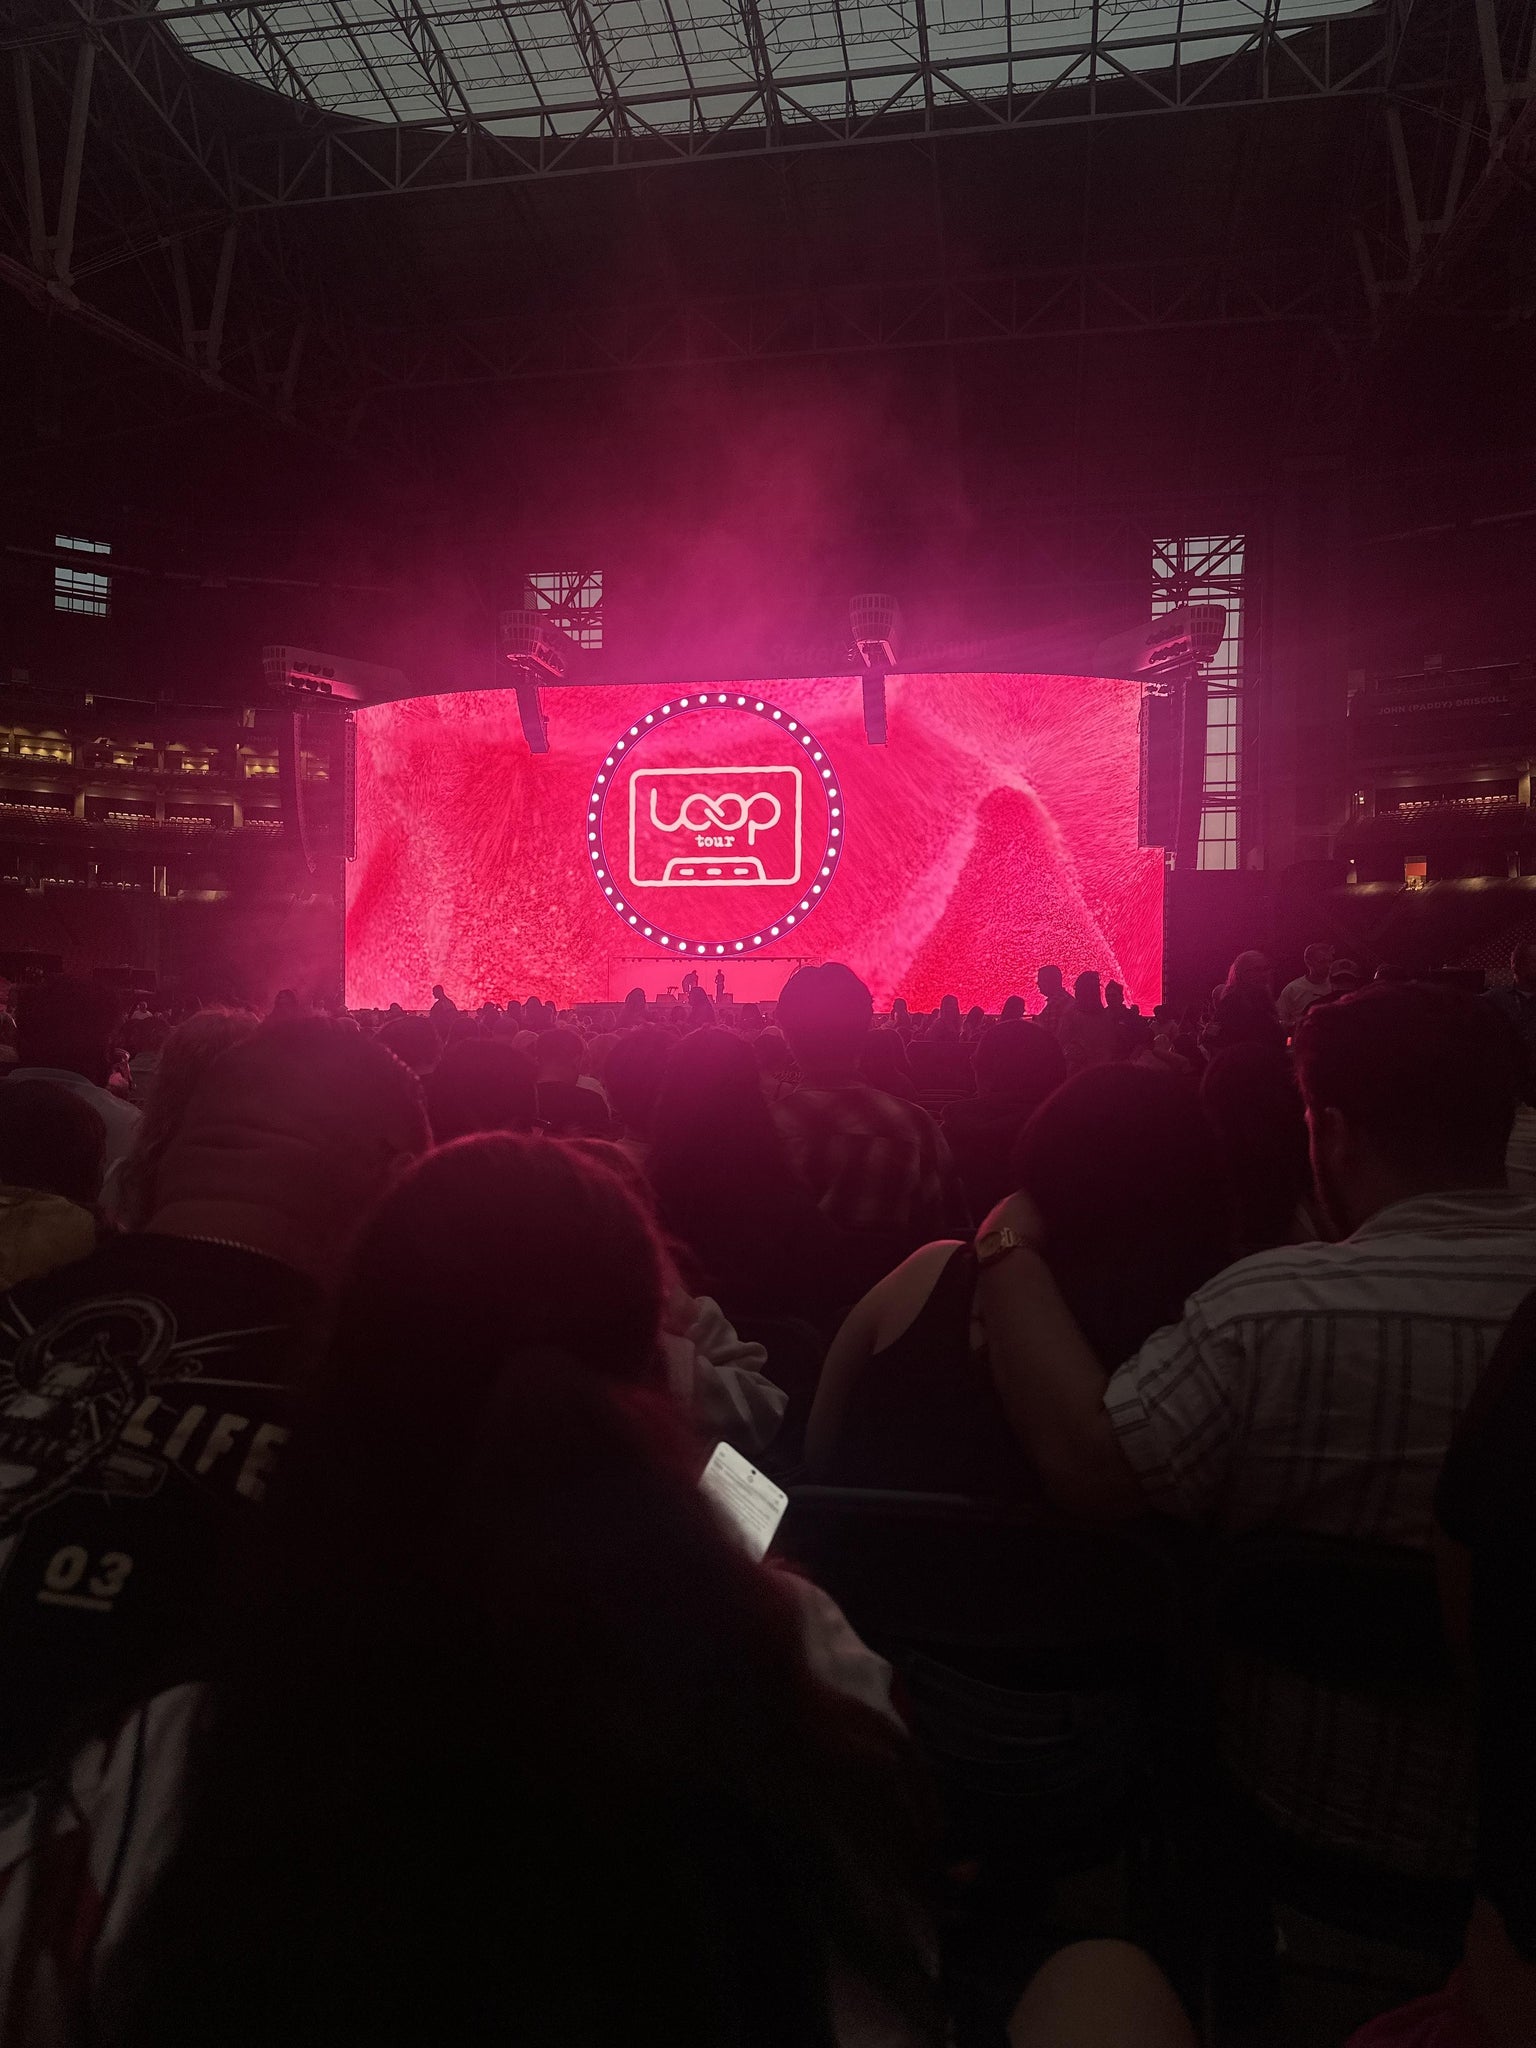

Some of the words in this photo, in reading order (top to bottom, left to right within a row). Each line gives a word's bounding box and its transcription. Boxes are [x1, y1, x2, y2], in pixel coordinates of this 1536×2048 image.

[1378, 705, 1406, 716] JOHN
[1408, 701, 1453, 713] (PADDY)
[1455, 695, 1509, 708] DRISCOLL
[694, 834, 736, 848] tour
[121, 1396, 290, 1503] LIFE
[43, 1544, 135, 1598] 03
